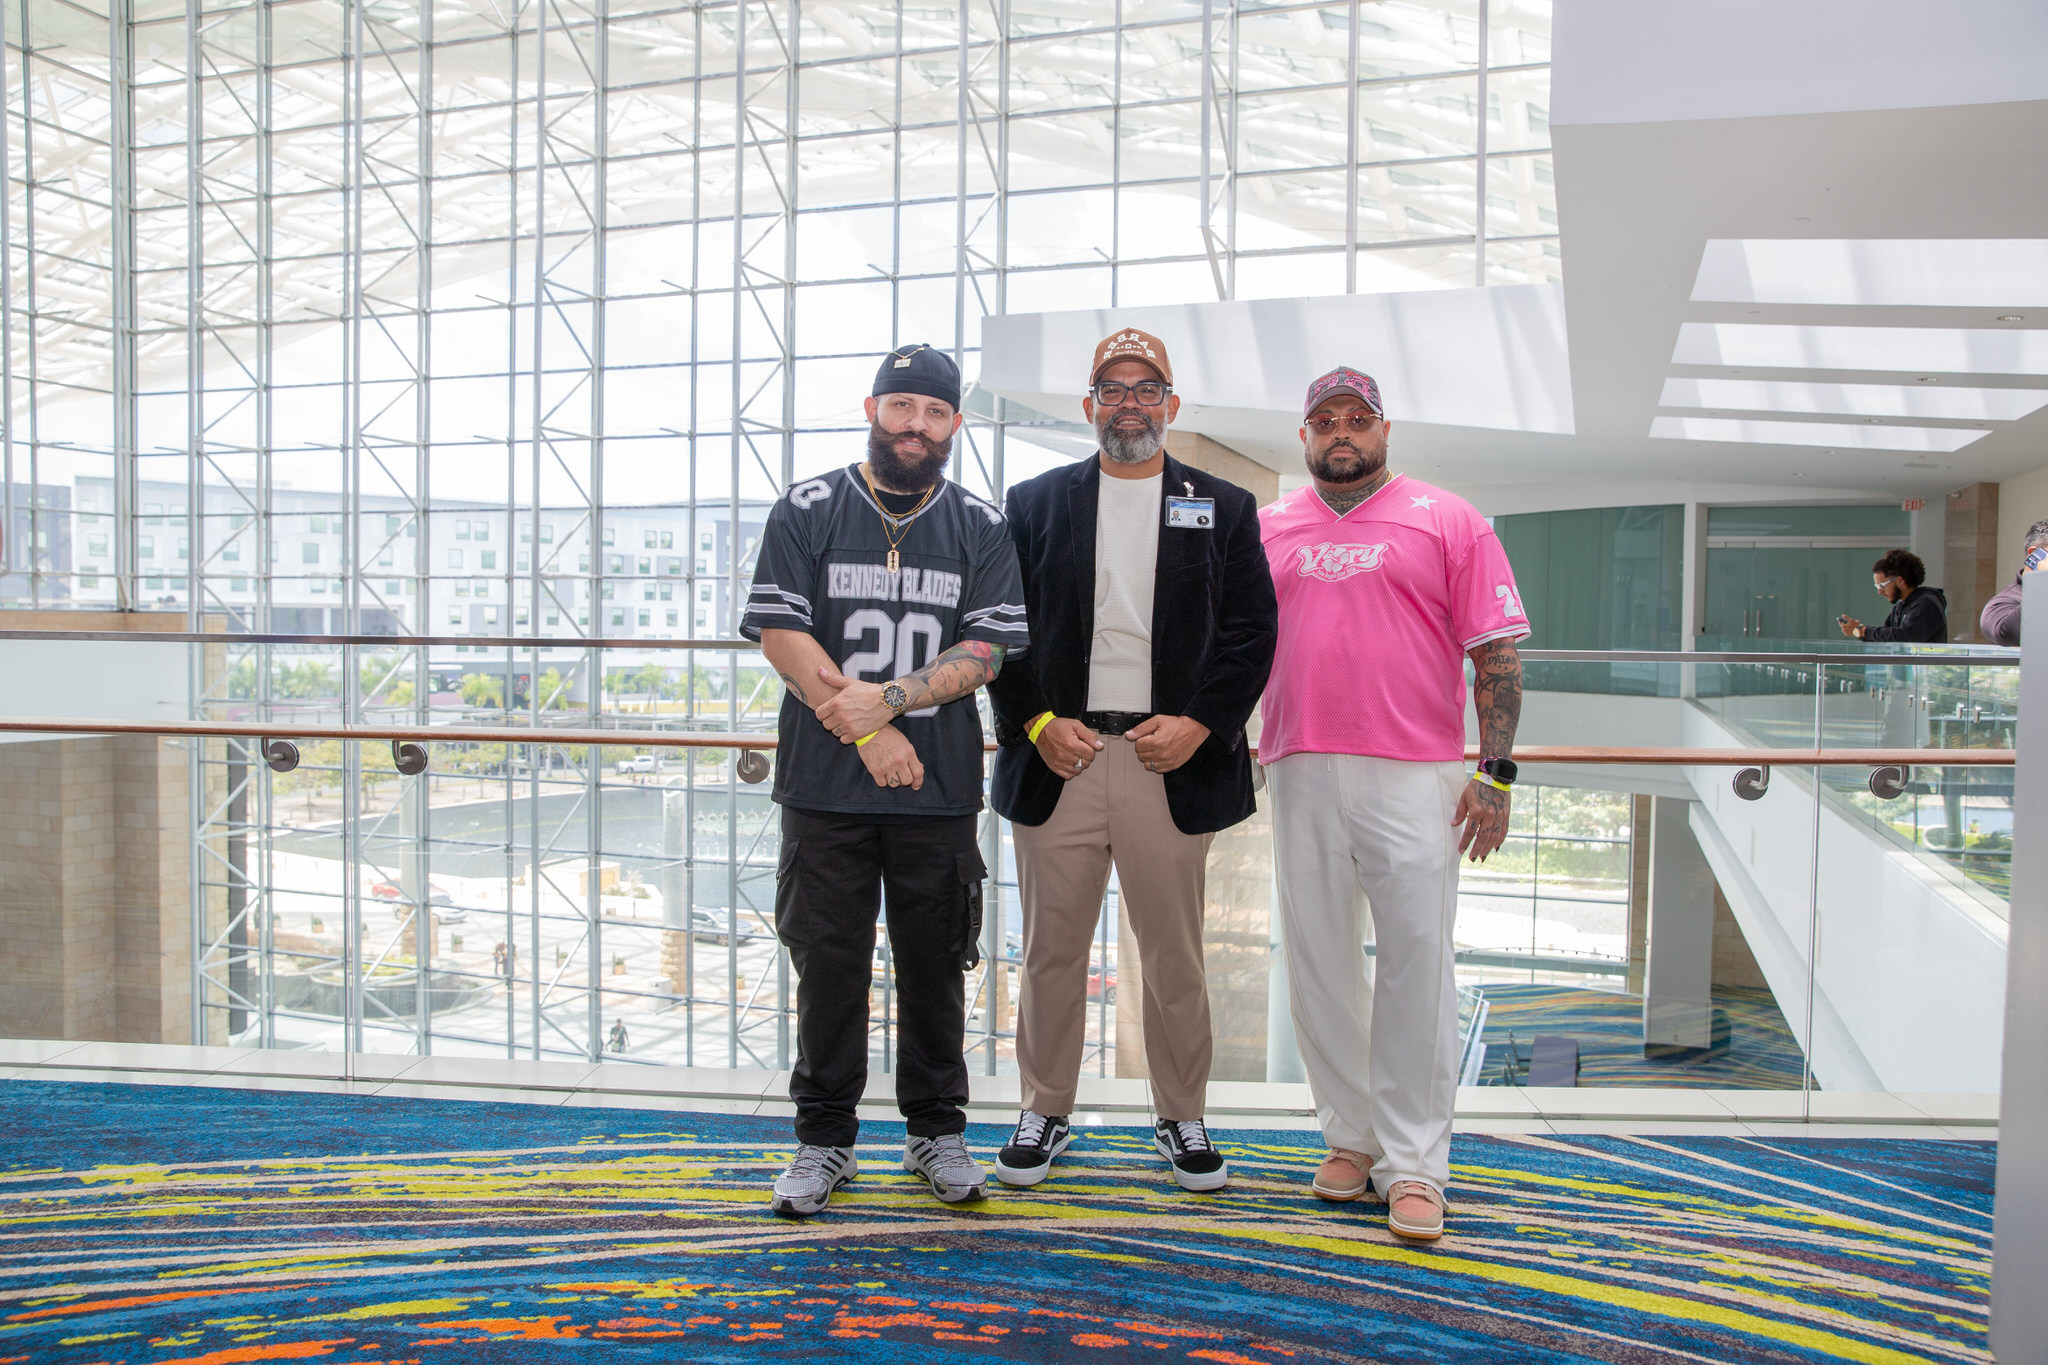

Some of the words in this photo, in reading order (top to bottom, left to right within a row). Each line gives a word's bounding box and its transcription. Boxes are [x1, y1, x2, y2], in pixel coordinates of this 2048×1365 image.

[1905, 499, 1922, 511] EXIT
[828, 562, 901, 602] KENNEDY
[901, 566, 962, 609] BLADES
[842, 609, 942, 718] 20
